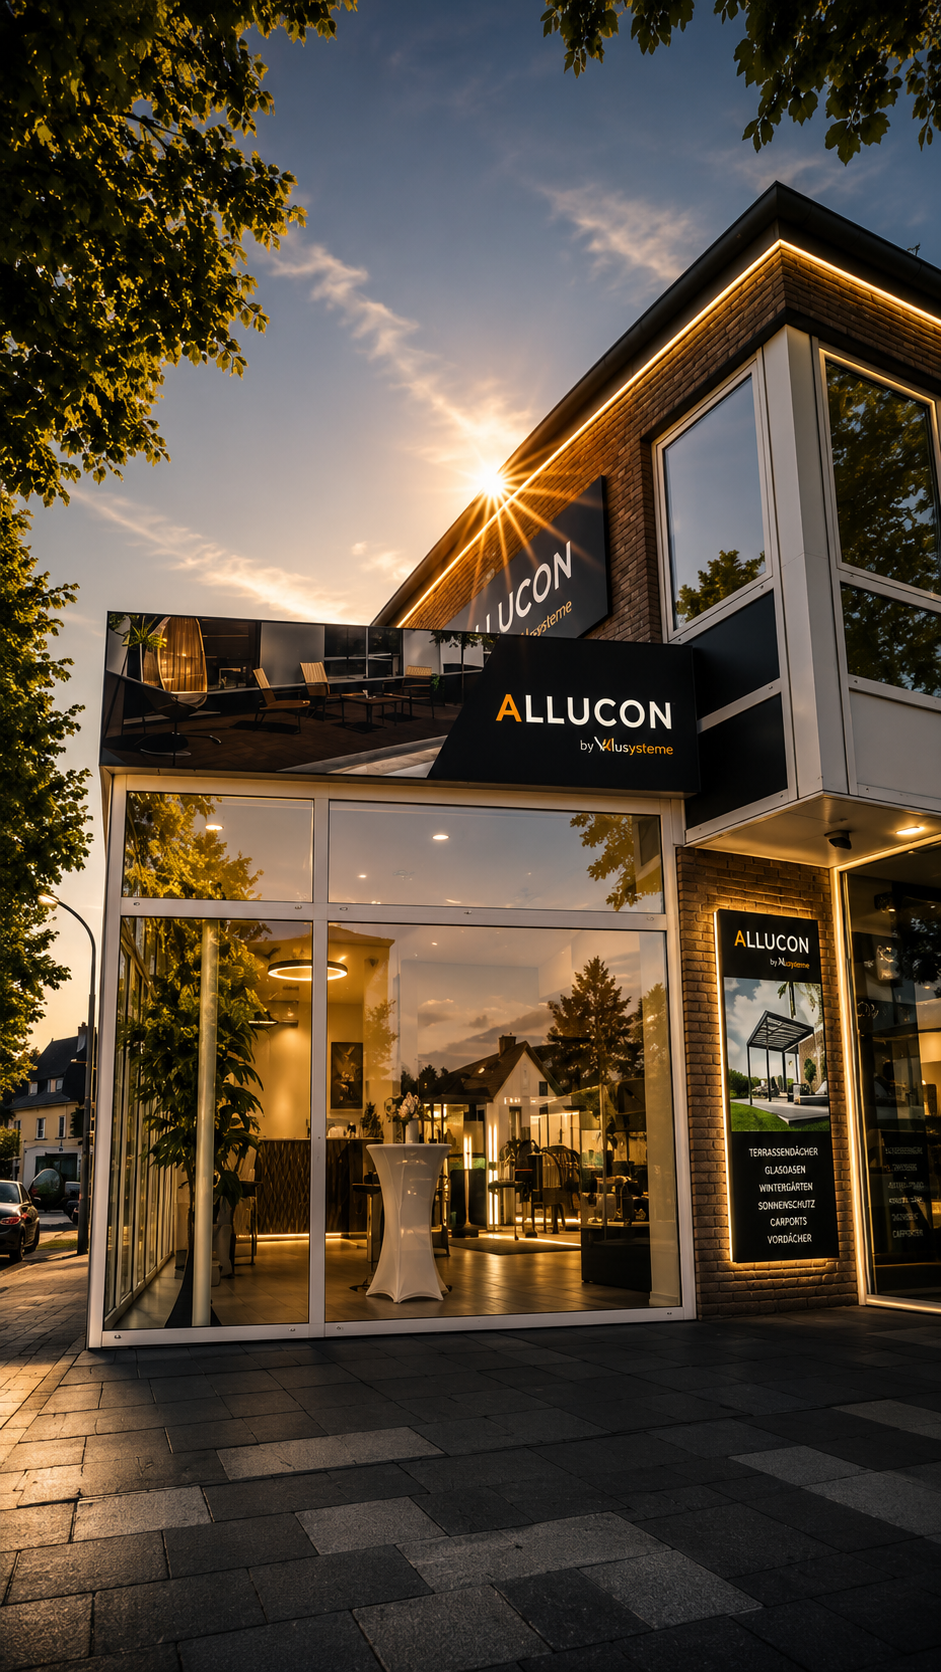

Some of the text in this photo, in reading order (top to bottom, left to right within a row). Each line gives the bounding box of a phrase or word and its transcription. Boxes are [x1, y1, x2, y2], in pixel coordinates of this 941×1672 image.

[495, 693, 672, 729] ALLUCON
[580, 740, 594, 754] by
[734, 930, 809, 954] ALLUCON
[769, 958, 778, 968] by
[748, 1145, 819, 1157] TERRASSENDÄCHER
[764, 1165, 806, 1175] GLASOASEN
[758, 1181, 813, 1192] WINTERGÄRTEN
[766, 1232, 812, 1244] VORDÄCHER
